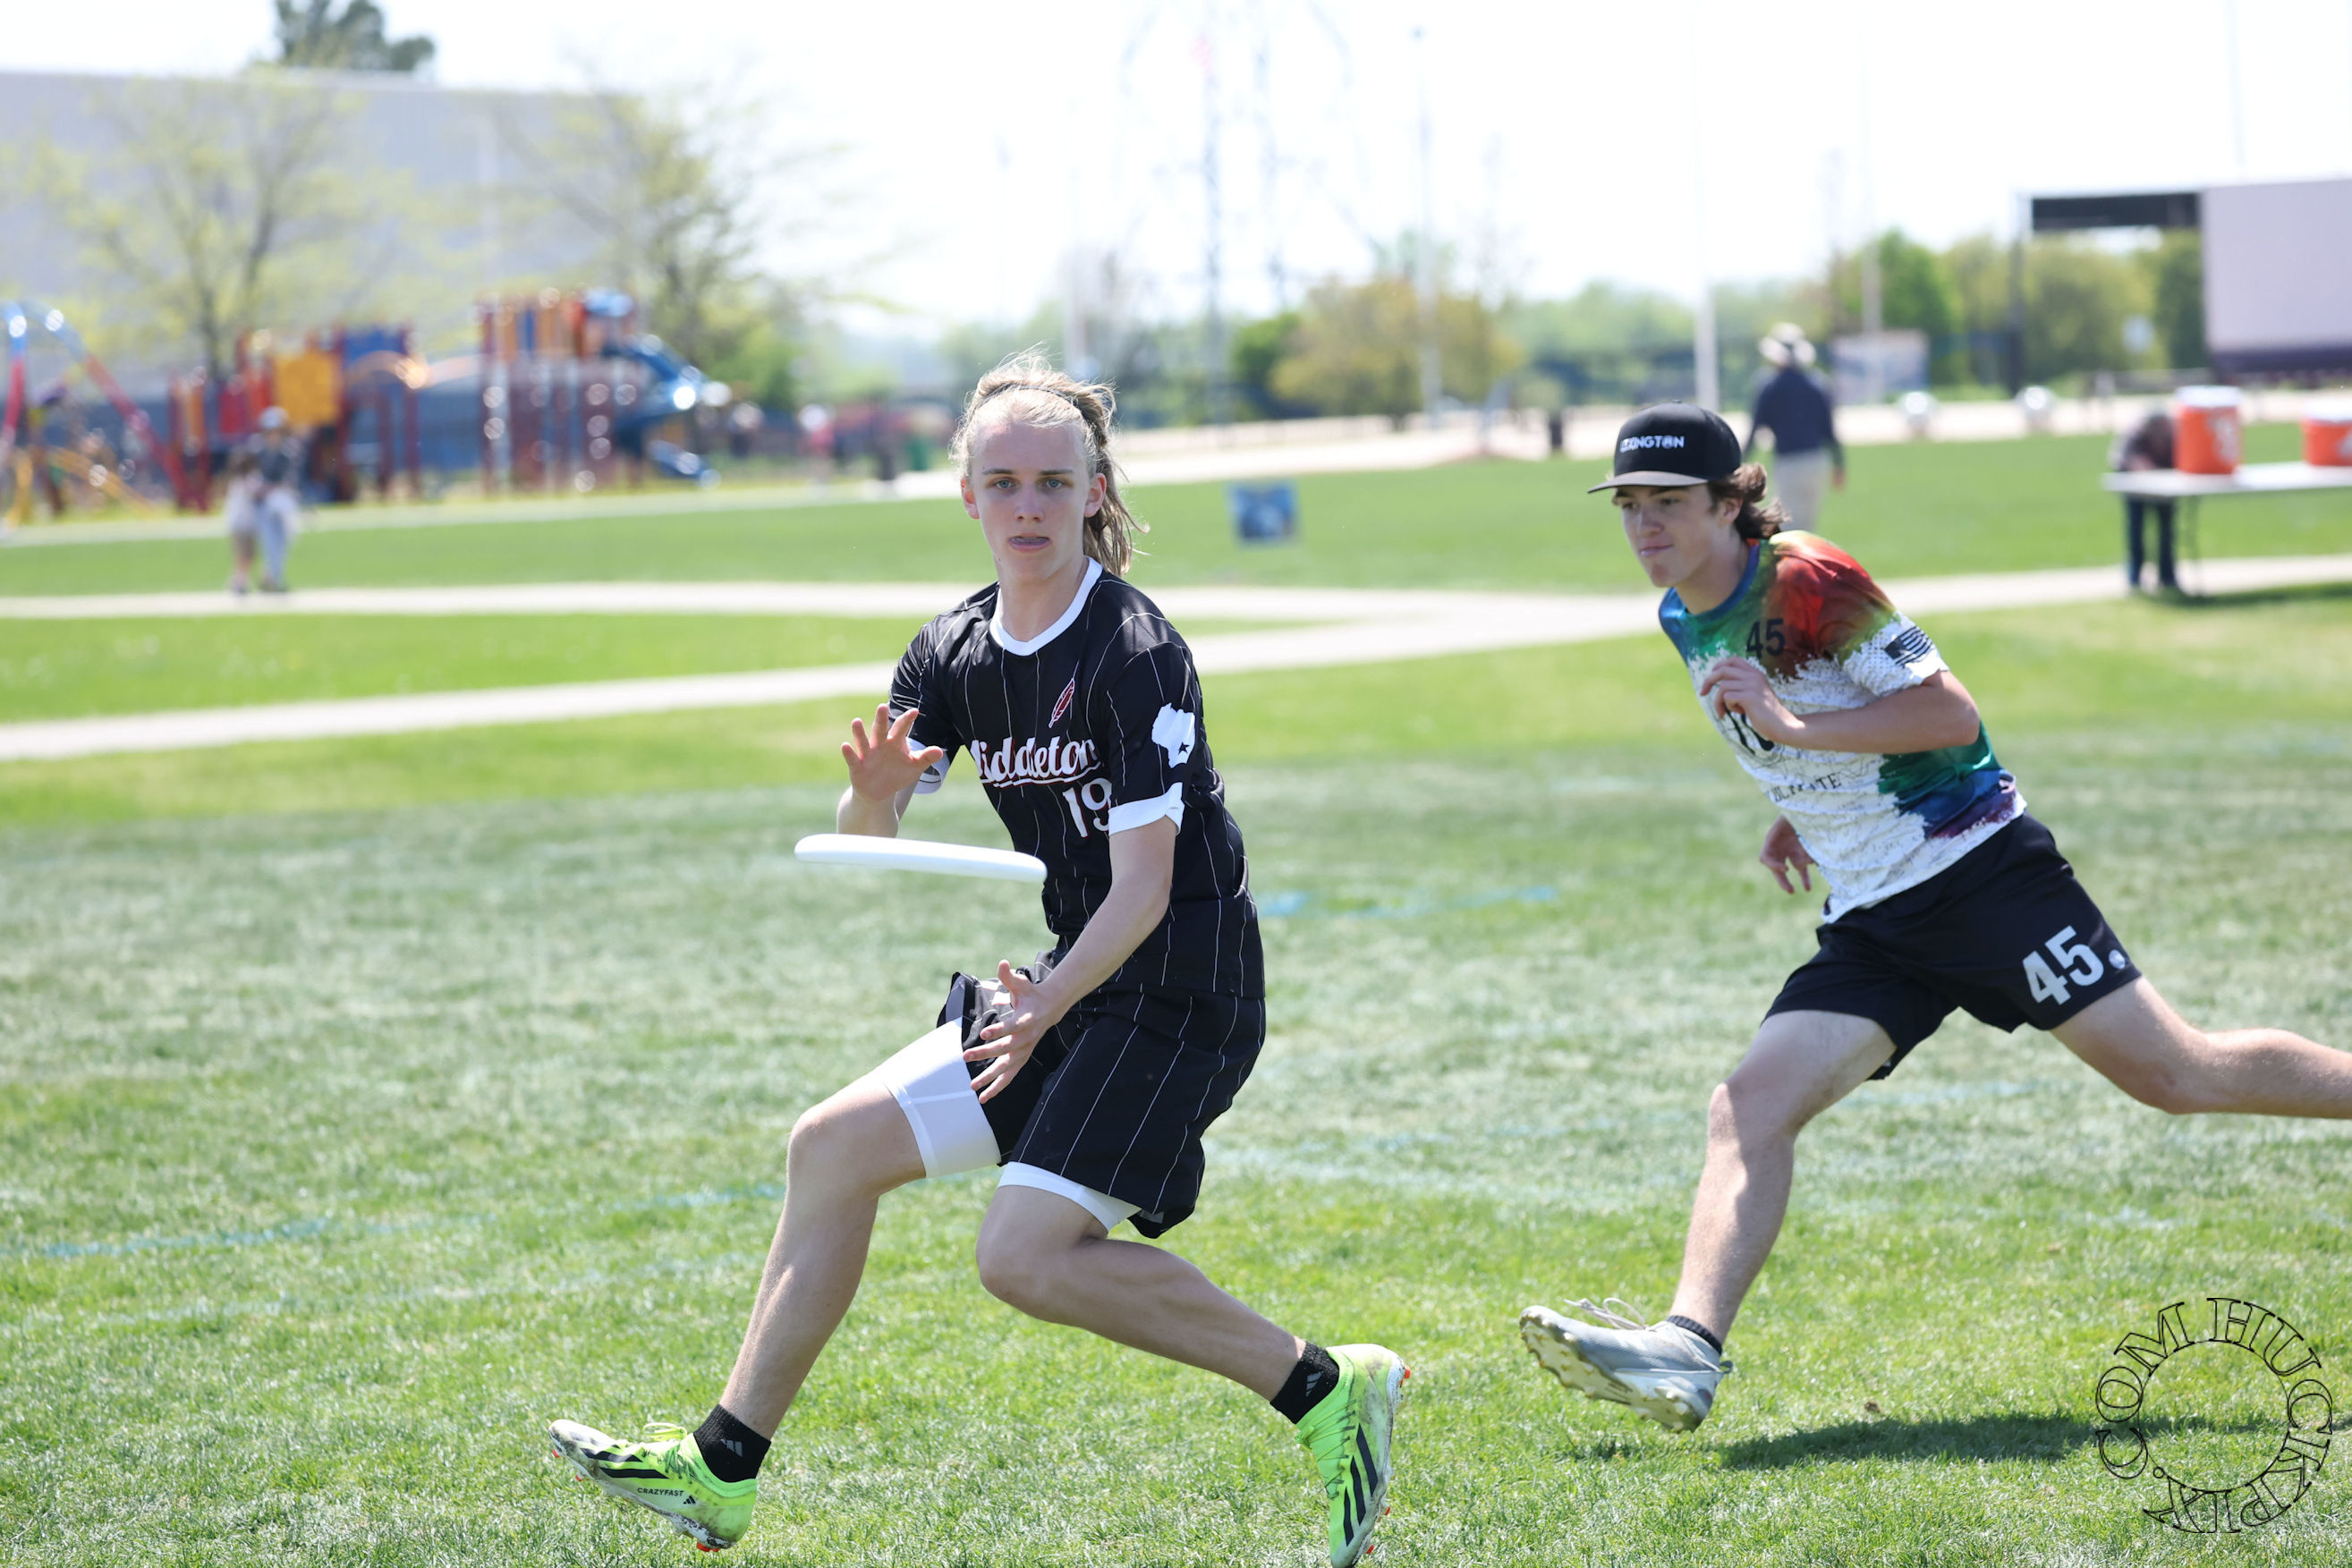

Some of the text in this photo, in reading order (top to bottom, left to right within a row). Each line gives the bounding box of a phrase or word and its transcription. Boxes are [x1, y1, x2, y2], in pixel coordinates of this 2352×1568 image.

[1745, 617, 1786, 660] 45
[1062, 777, 1113, 838] 19
[2022, 925, 2104, 1005] 45
[637, 1487, 685, 1497] CRAZYFAST
